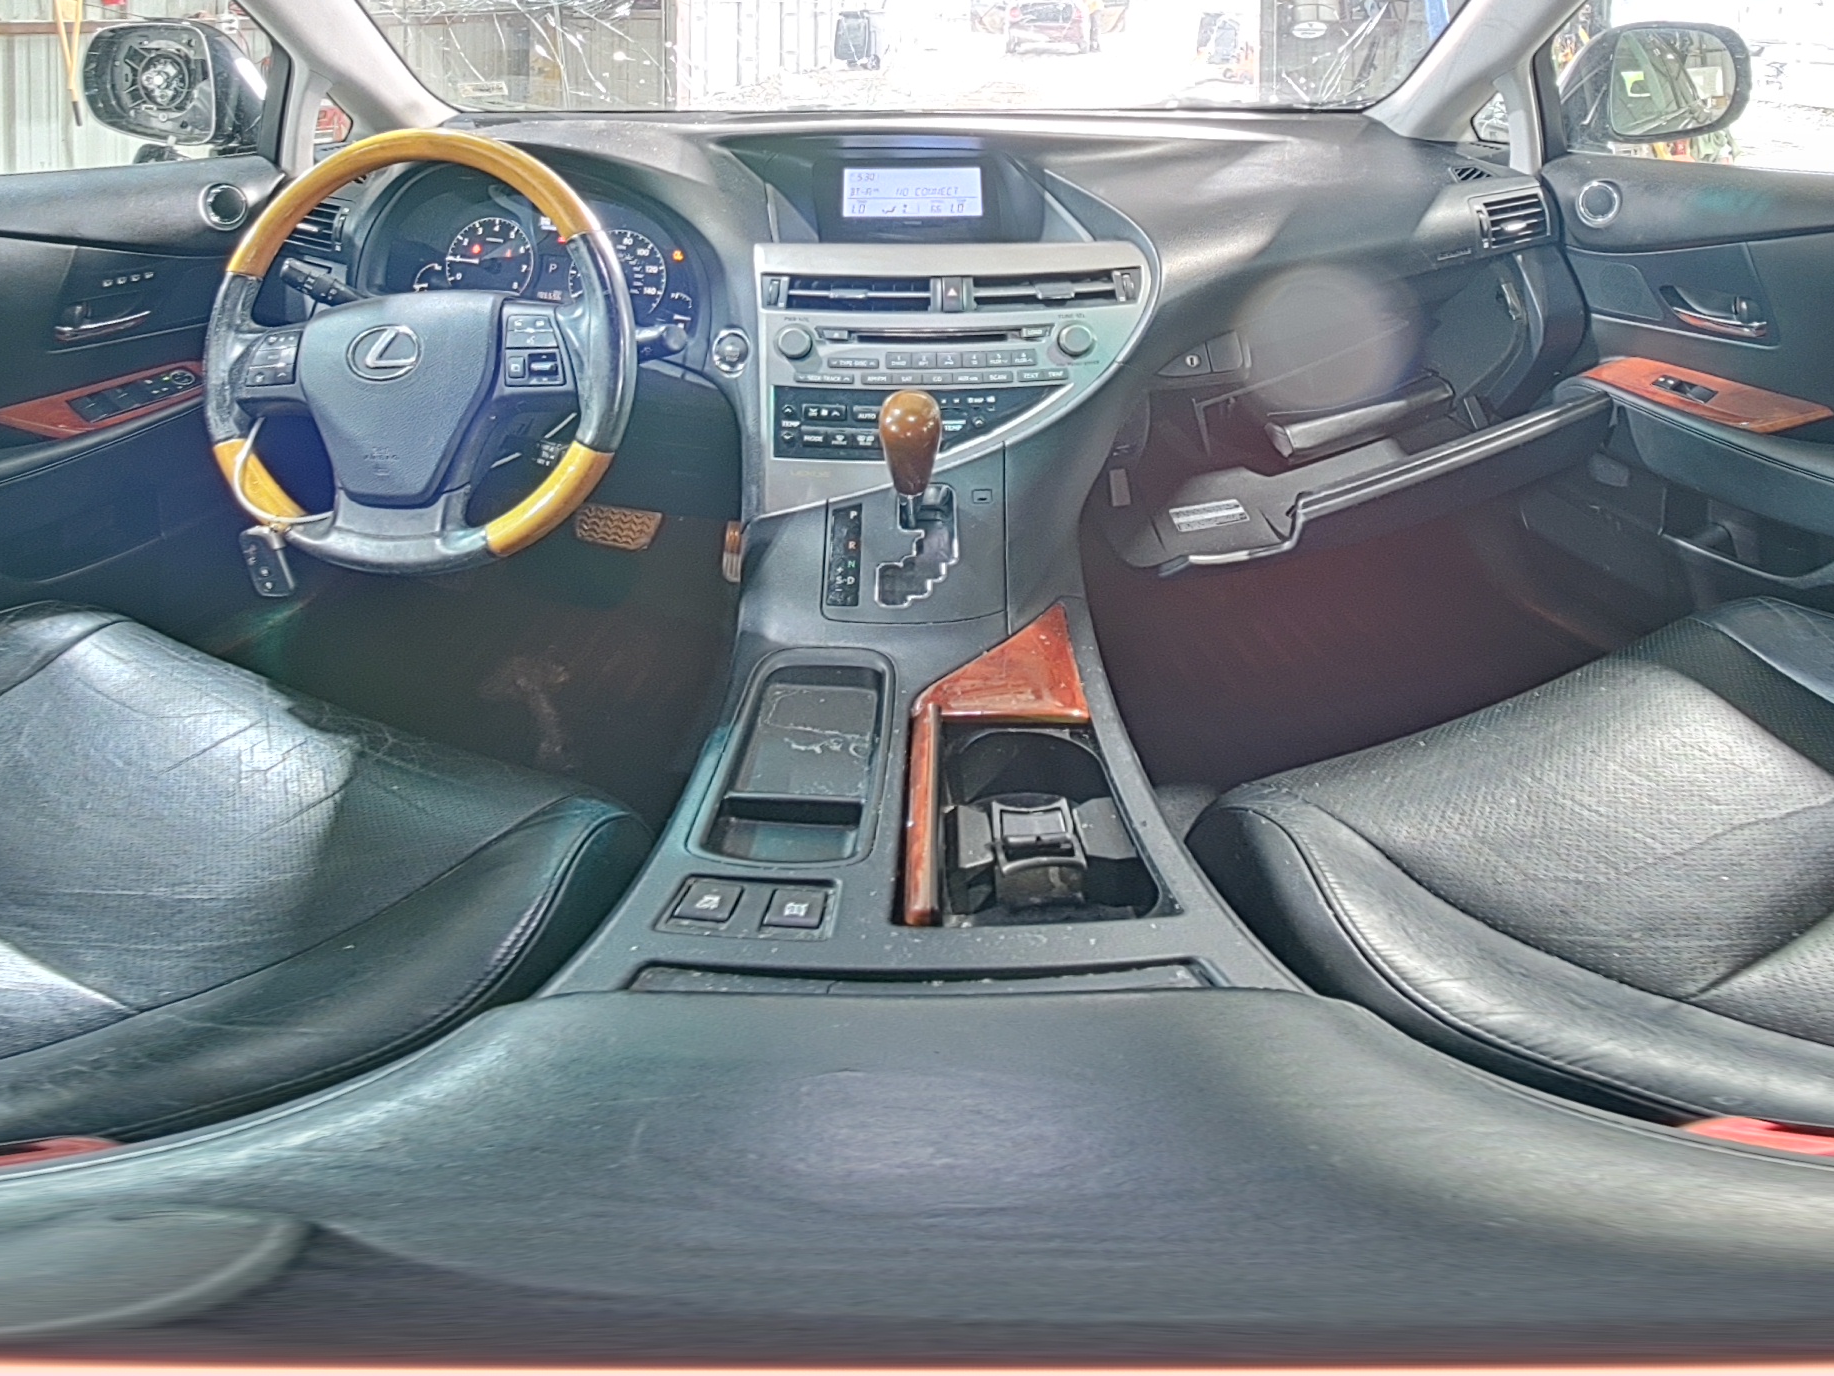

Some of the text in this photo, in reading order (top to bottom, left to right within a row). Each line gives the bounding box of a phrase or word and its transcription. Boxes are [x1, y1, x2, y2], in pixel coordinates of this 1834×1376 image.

[636, 249, 649, 257] 100
[549, 263, 557, 273] P
[645, 266, 658, 274] 120
[643, 287, 656, 295] 140
[803, 434, 823, 442] MODE
[849, 510, 858, 520] P
[848, 541, 857, 549] R
[847, 560, 856, 568] N
[846, 576, 855, 585] D
